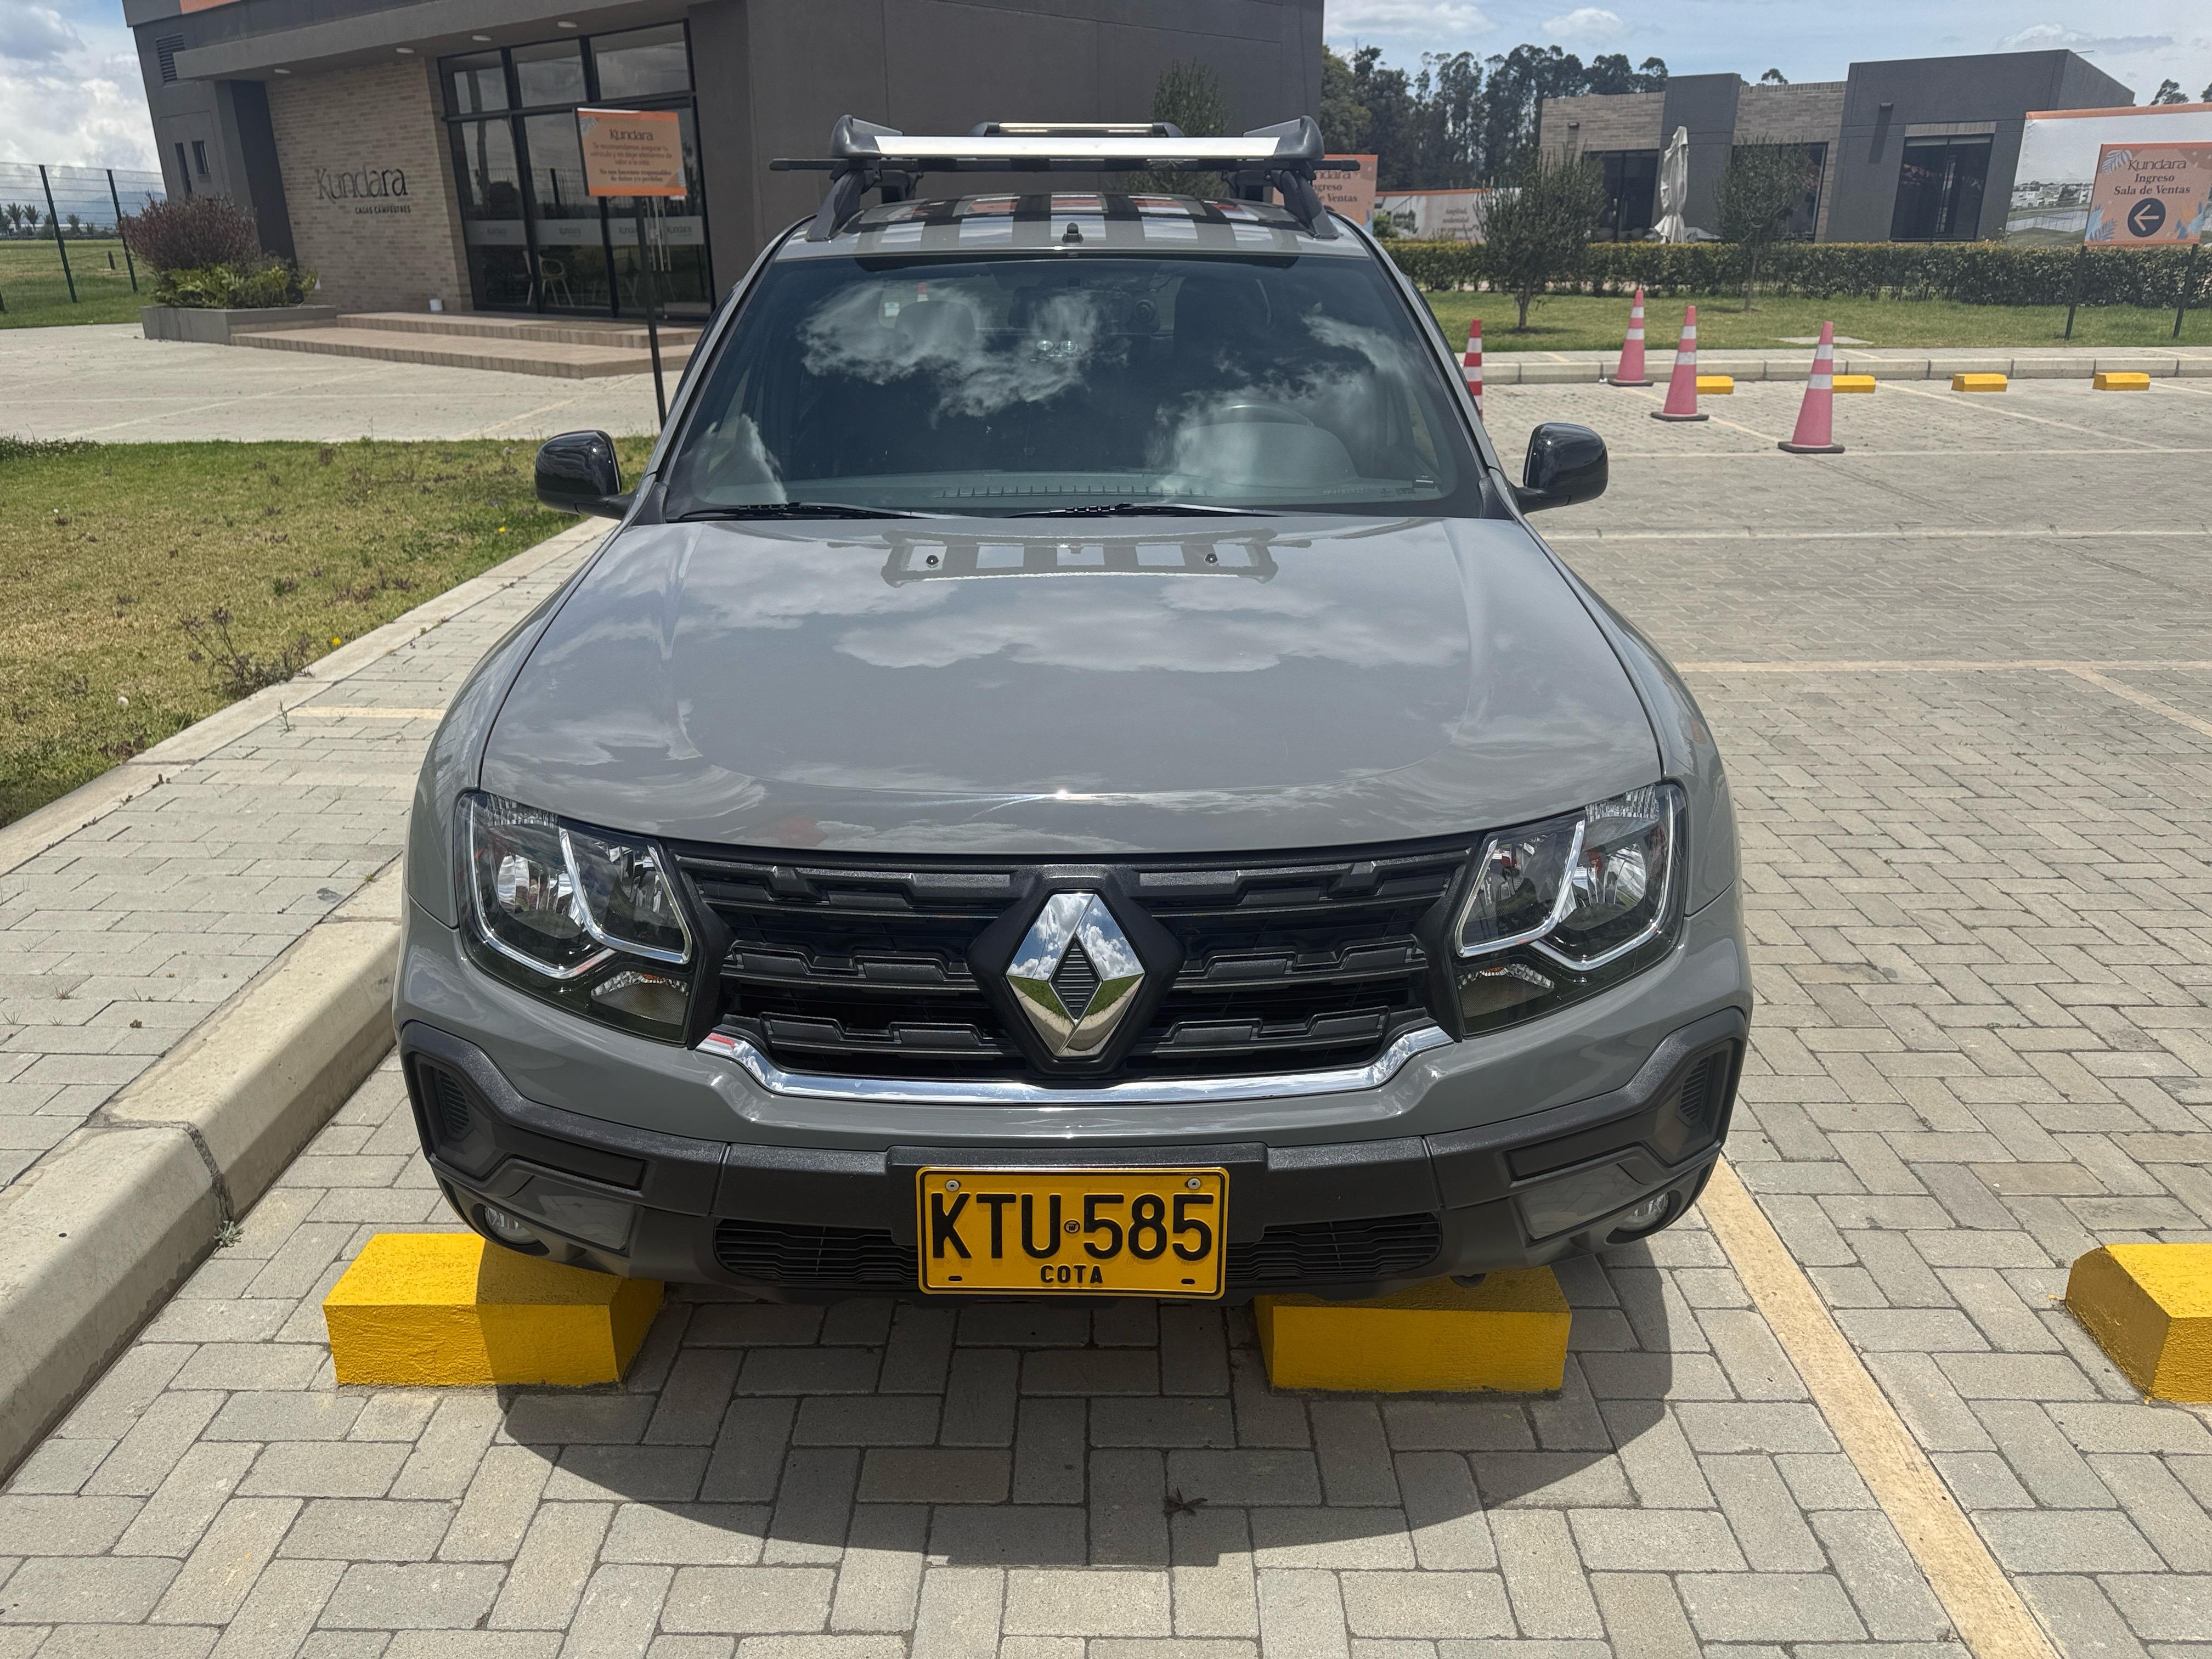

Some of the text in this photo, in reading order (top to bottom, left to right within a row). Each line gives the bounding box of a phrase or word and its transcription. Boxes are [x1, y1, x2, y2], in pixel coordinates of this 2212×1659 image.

[610, 128, 653, 140] Kundara
[2128, 159, 2187, 171] Kundara
[315, 164, 408, 204] Kundara
[2135, 173, 2175, 184] Ingreso
[2114, 185, 2191, 195] Sala de Ventas
[1327, 193, 1358, 202] Ventas
[355, 205, 411, 214] CASAS CAMPESTRES
[931, 1192, 1215, 1261] KTU 585
[1040, 1264, 1104, 1284] COTA
